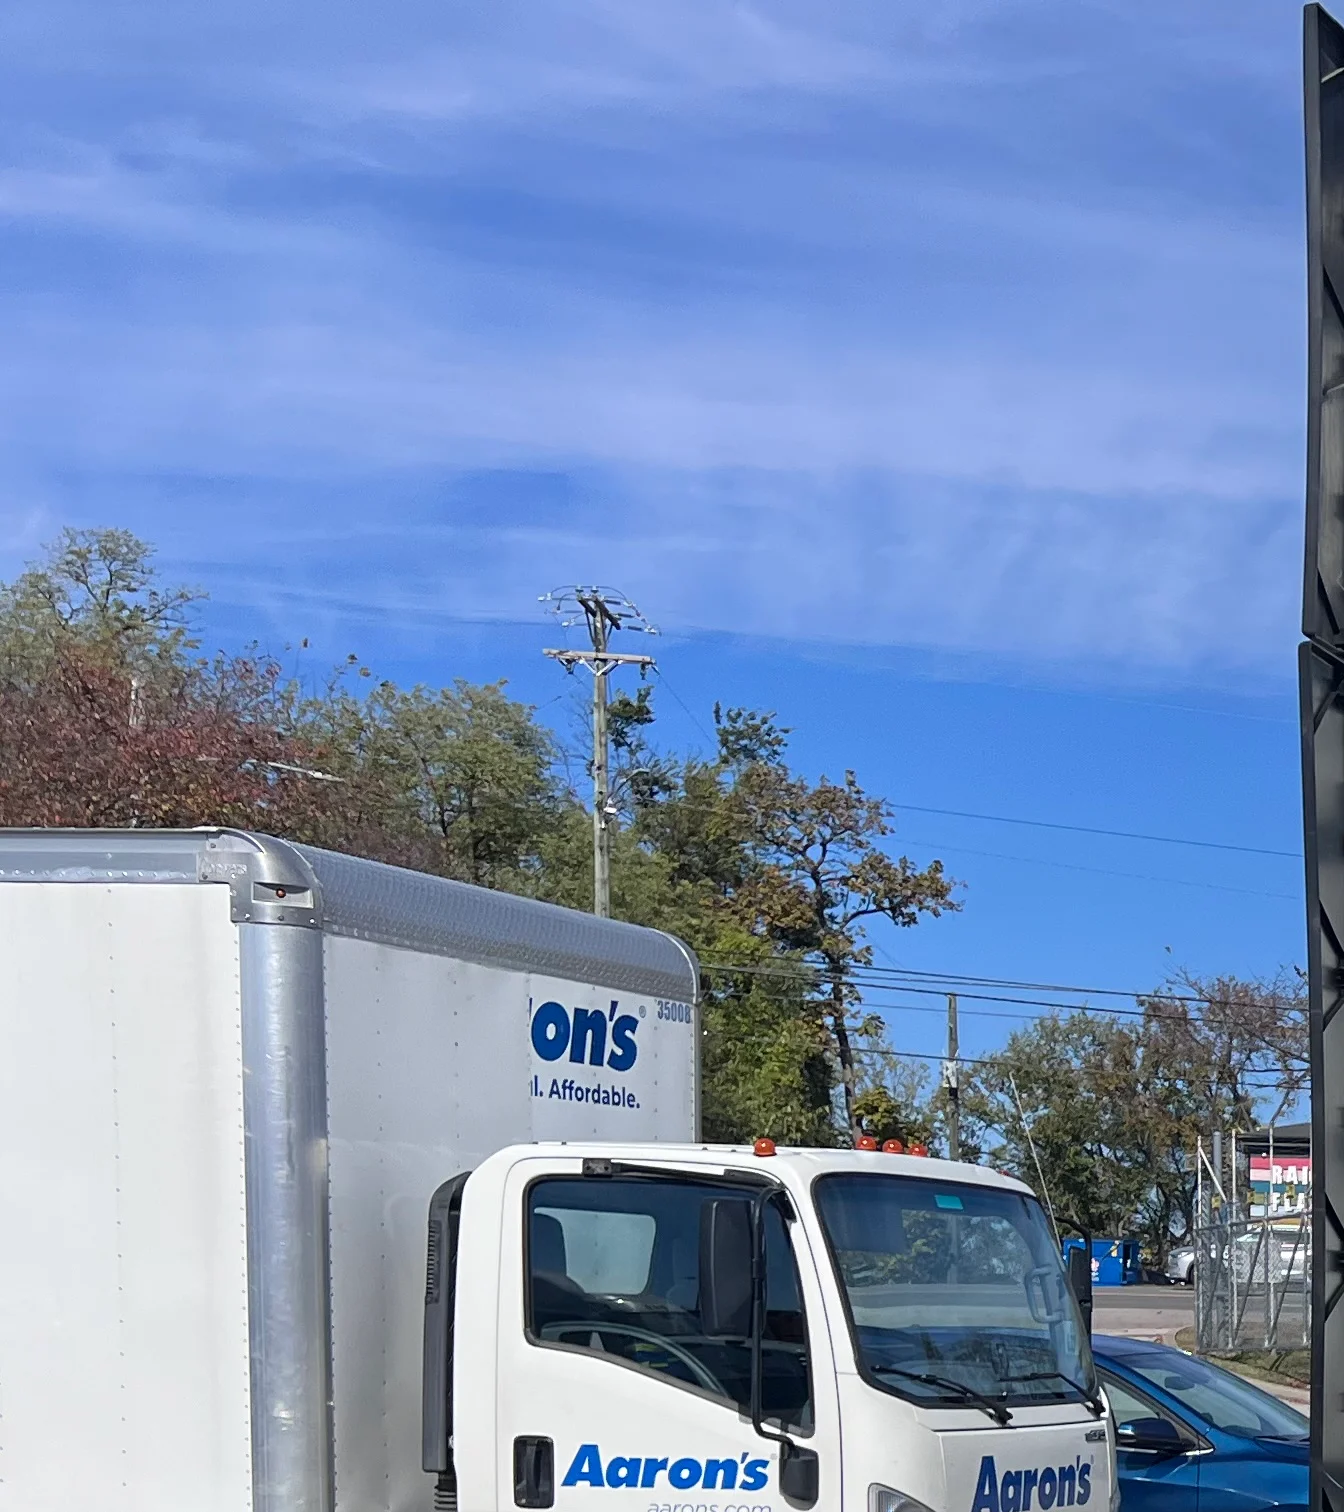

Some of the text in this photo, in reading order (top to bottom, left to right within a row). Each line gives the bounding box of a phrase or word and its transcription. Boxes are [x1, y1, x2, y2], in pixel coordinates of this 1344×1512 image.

[657, 1001, 691, 1024] 35008
[529, 998, 639, 1071] on's
[549, 1079, 640, 1109] Affordable.
[1272, 1165, 1312, 1185] RAI
[561, 1444, 770, 1491] Aaron's
